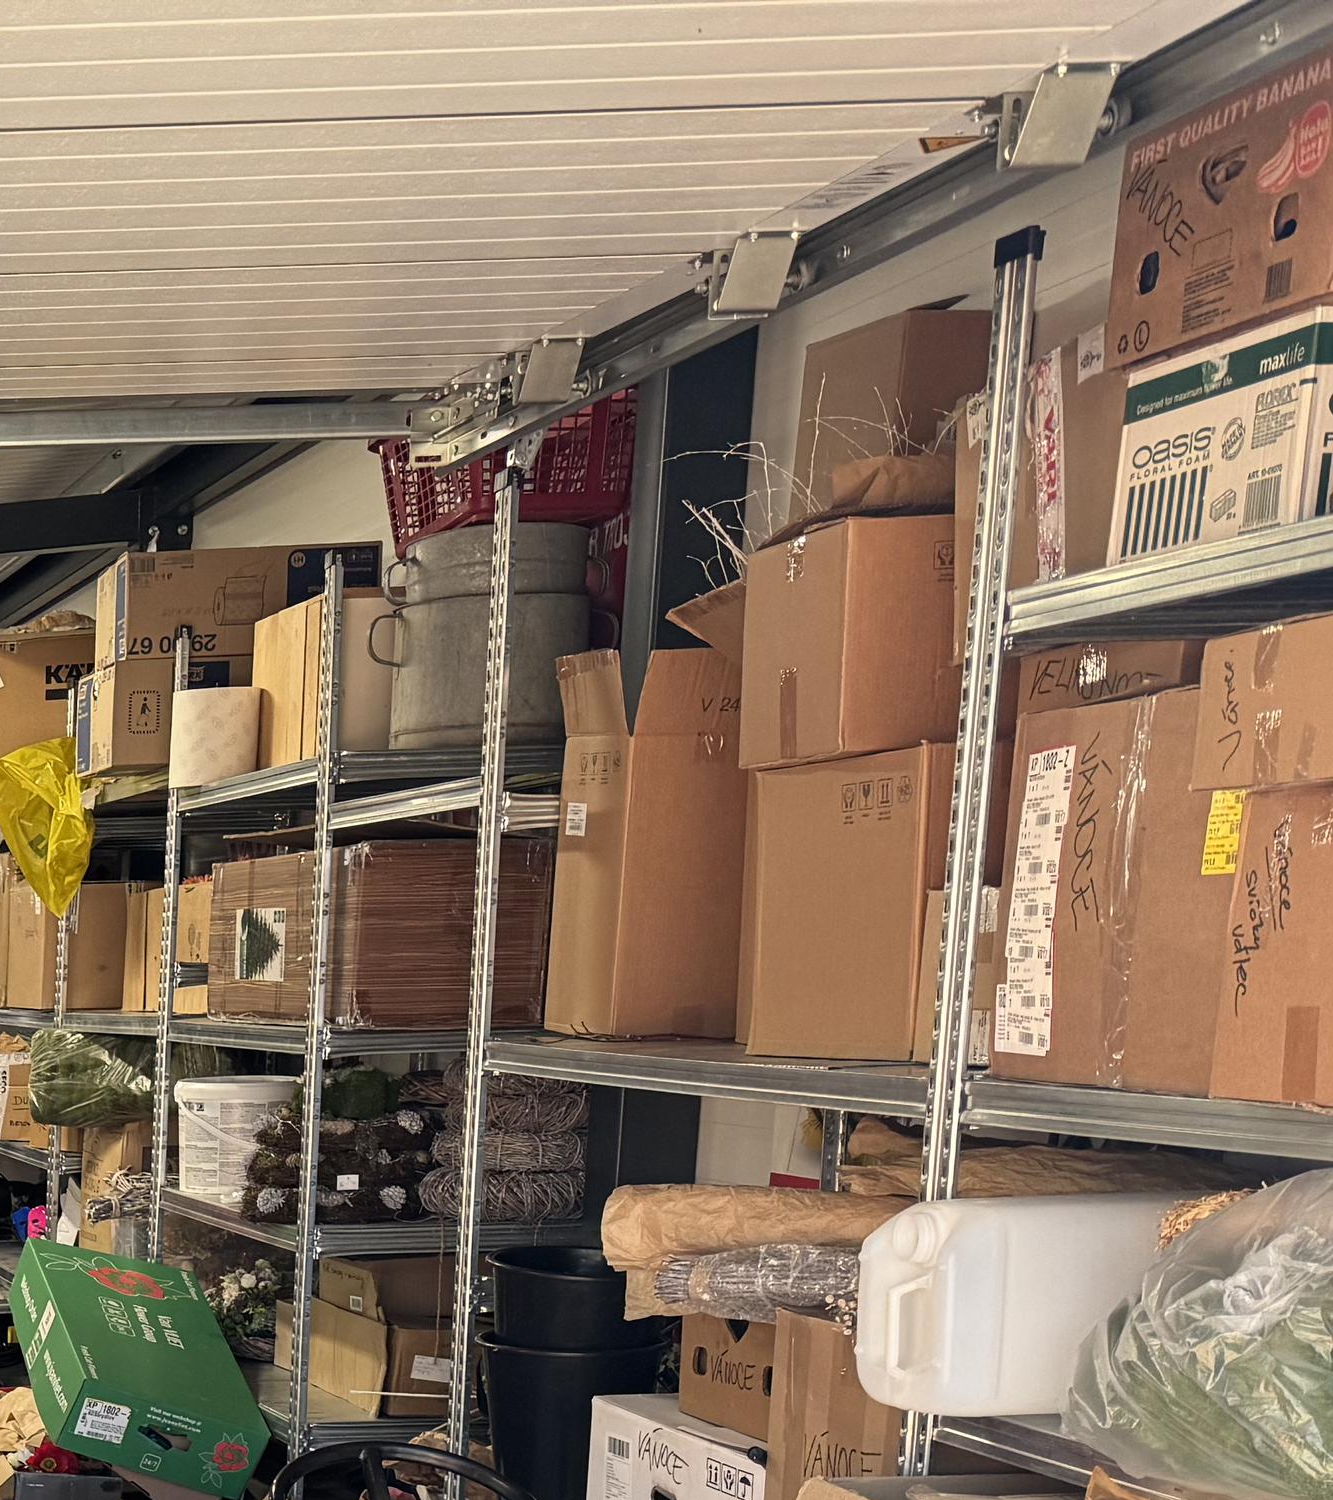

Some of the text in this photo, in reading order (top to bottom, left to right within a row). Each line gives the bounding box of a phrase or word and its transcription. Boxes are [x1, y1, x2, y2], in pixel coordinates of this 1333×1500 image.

[1131, 132, 1177, 172] FIRST
[1179, 95, 1256, 149] QUALITY
[1259, 341, 1305, 375] maxlife
[1129, 451, 1211, 483] FLORAL FOAM
[160, 633, 218, 652] 290
[701, 697, 713, 713] V
